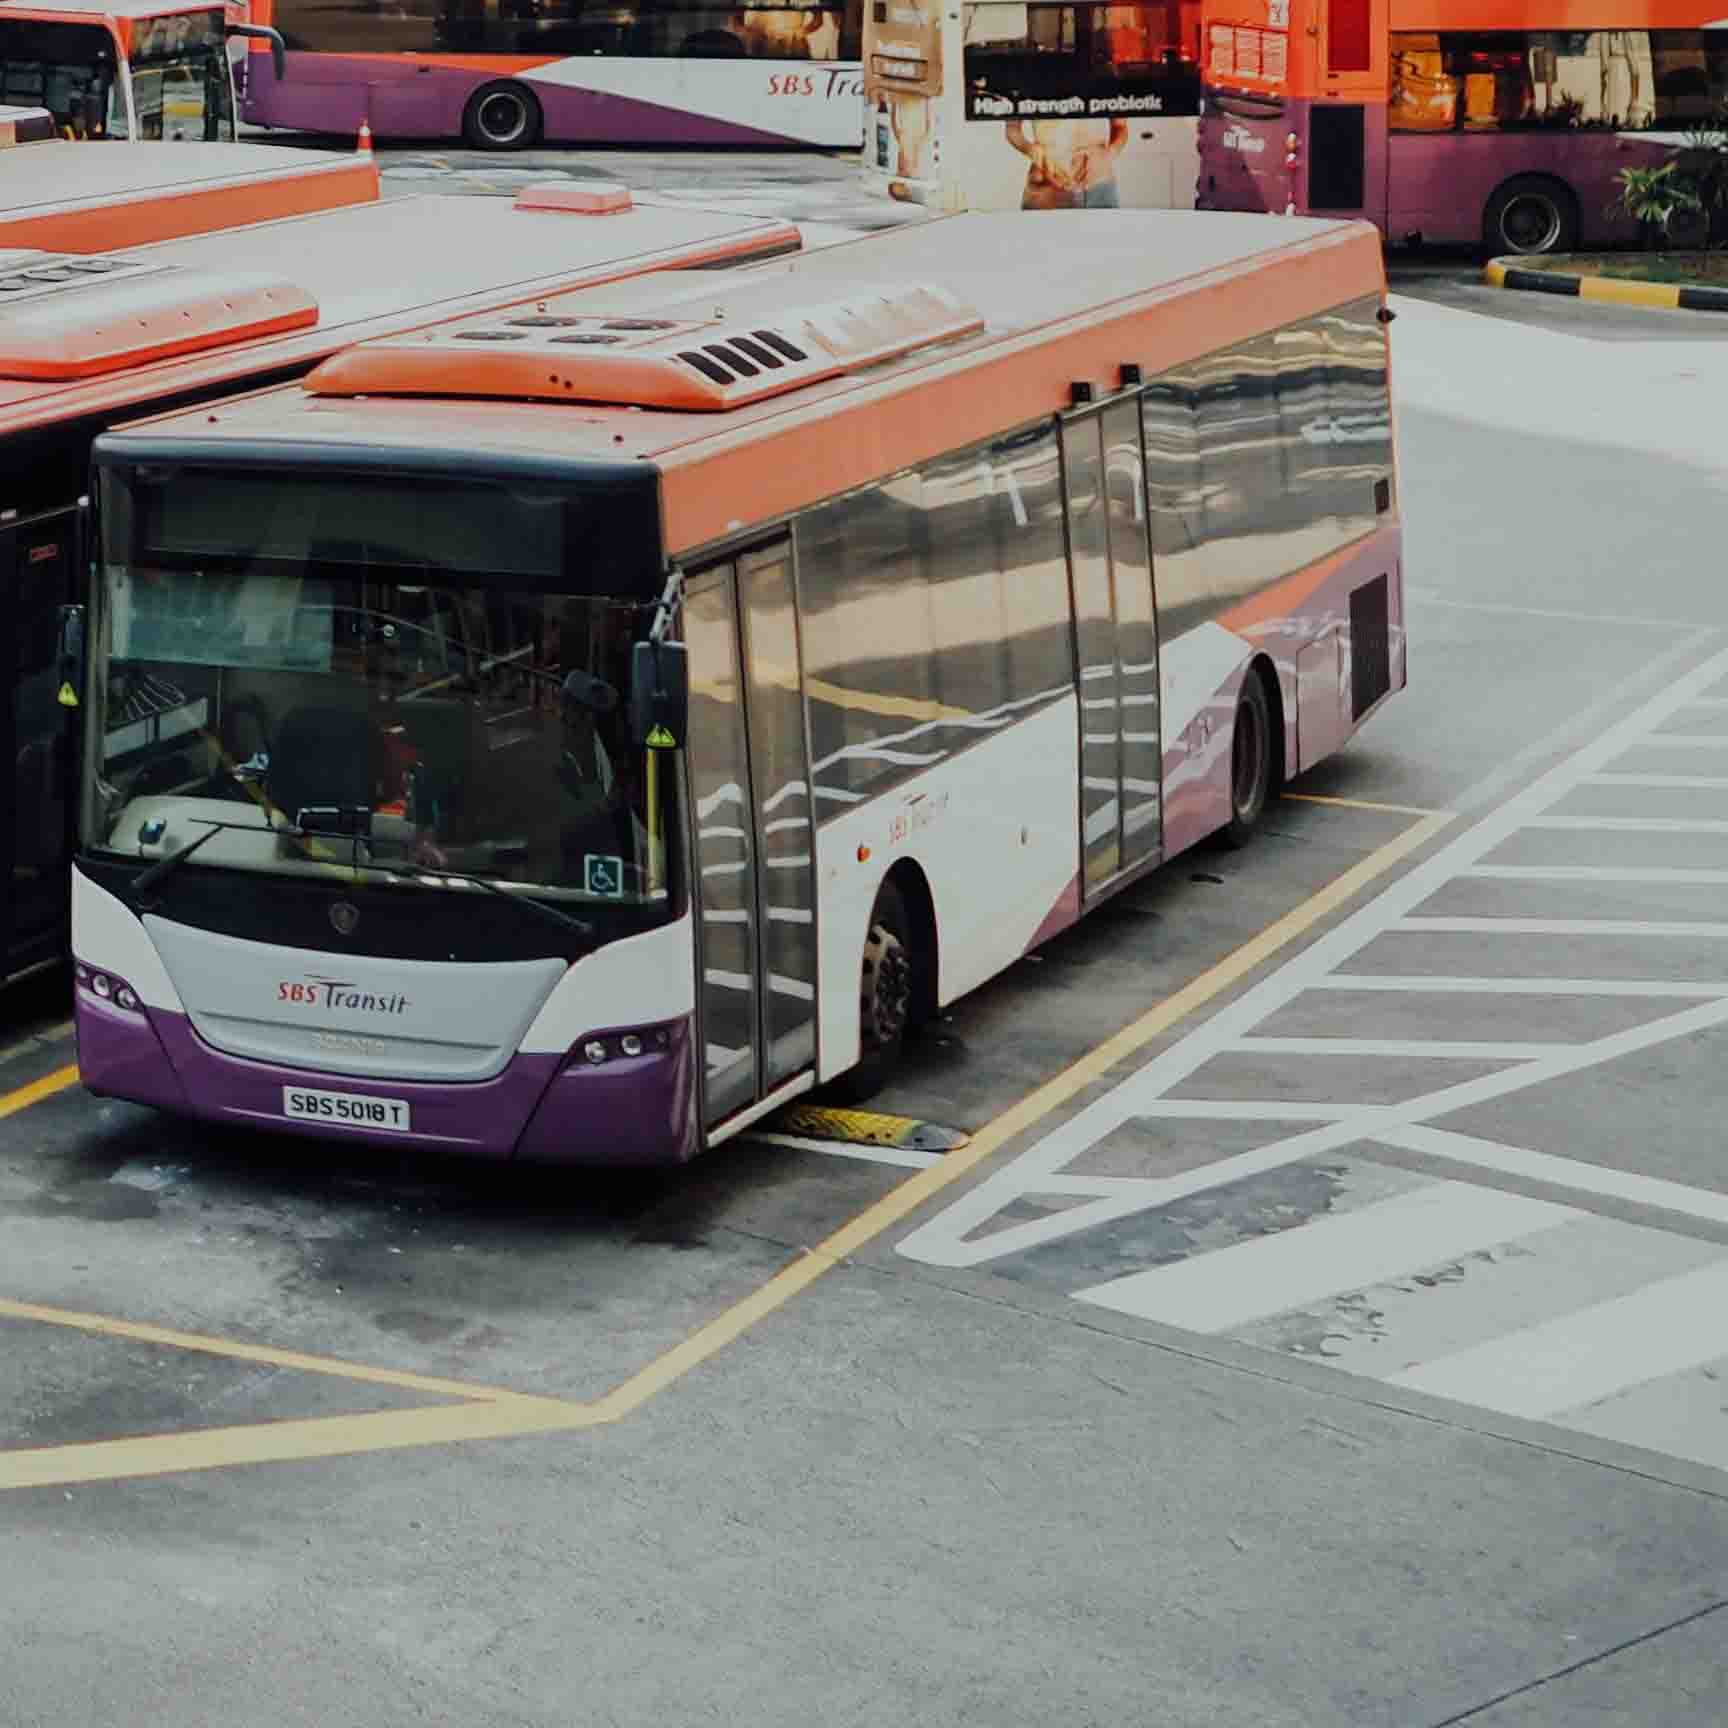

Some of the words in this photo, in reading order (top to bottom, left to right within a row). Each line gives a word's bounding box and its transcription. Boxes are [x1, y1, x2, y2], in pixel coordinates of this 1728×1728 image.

[767, 74, 814, 96] SBS
[974, 97, 1014, 115] High
[1018, 96, 1085, 114] strength
[278, 982, 318, 1004] SBS
[318, 982, 412, 1014] Transit
[291, 1093, 403, 1124] SBS5018T
